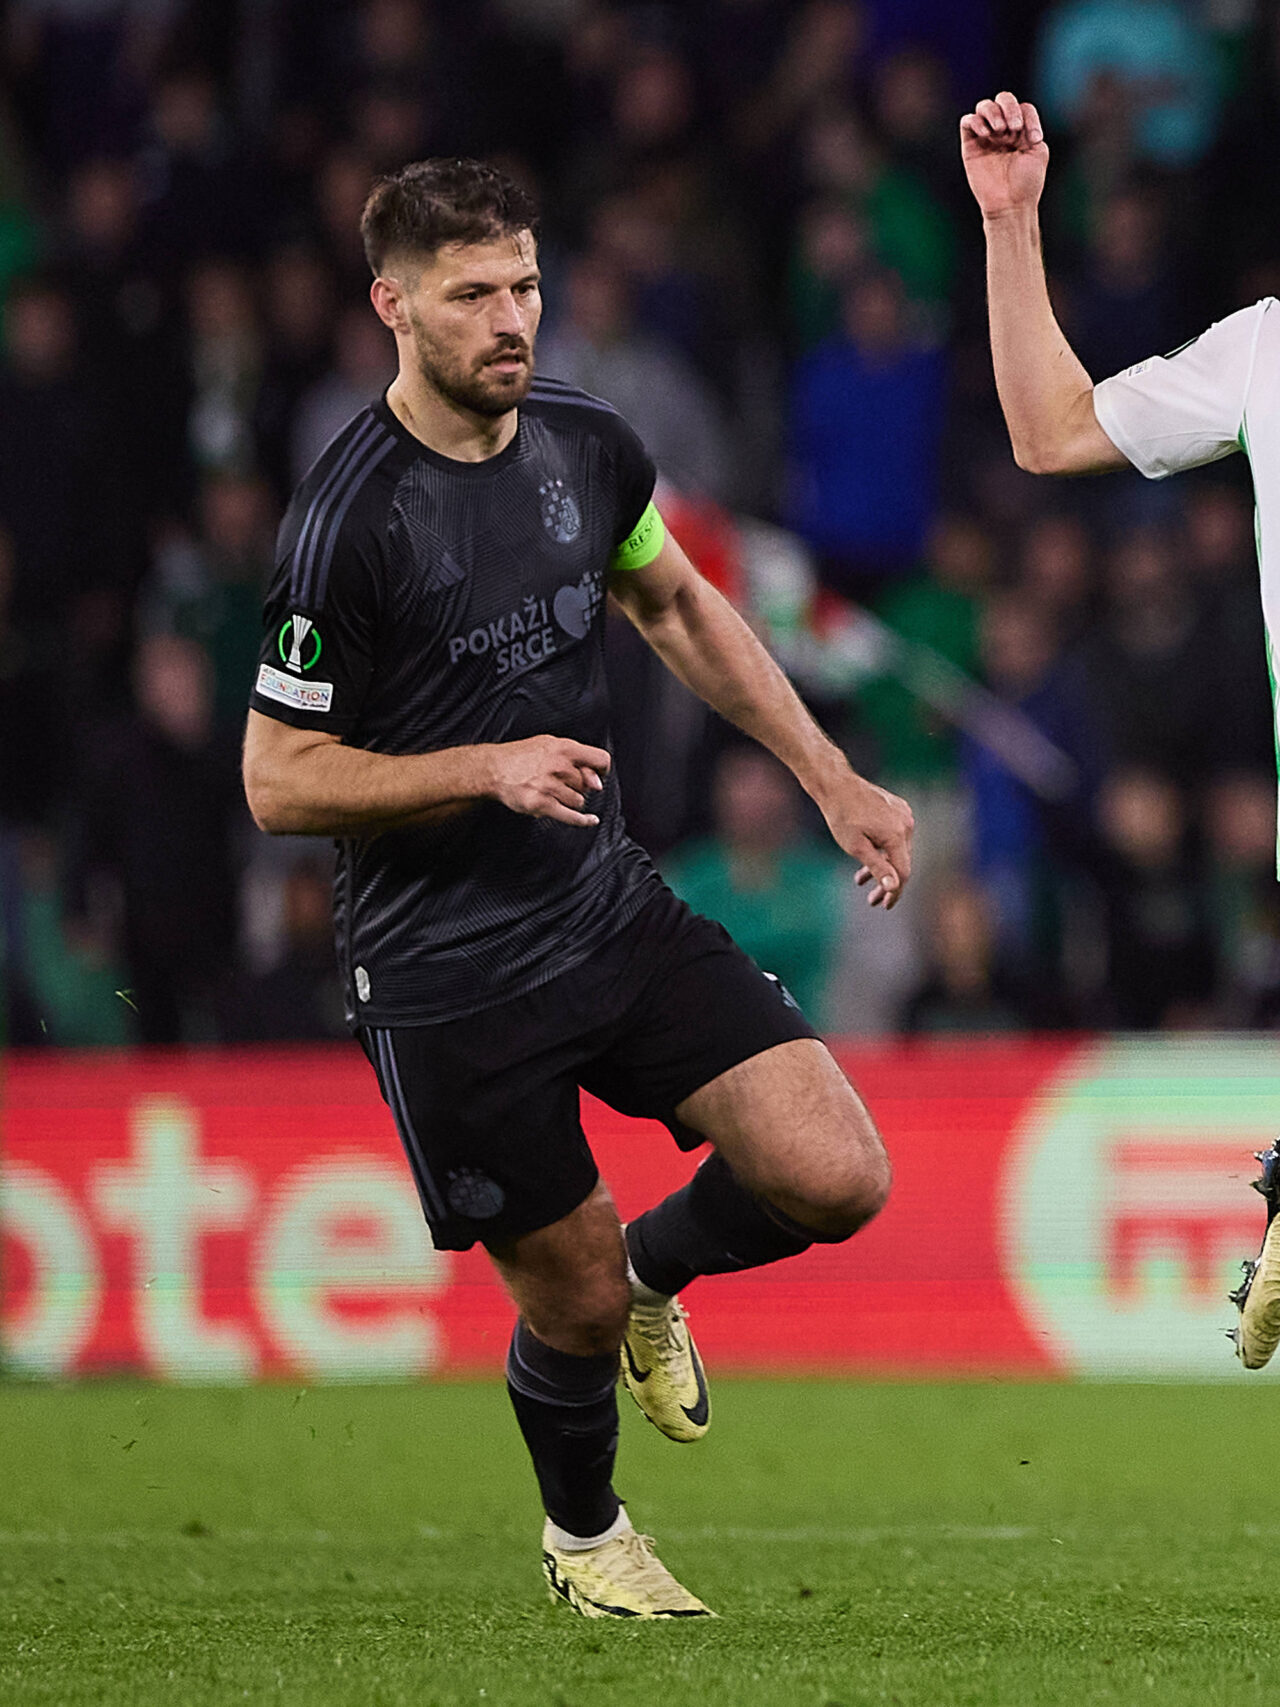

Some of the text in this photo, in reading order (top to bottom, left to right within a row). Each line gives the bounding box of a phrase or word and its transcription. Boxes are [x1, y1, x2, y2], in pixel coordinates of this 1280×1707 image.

[450, 595, 549, 664] POKAŽI
[497, 627, 558, 674] SRCE
[260, 673, 330, 703] FOUNDATION
